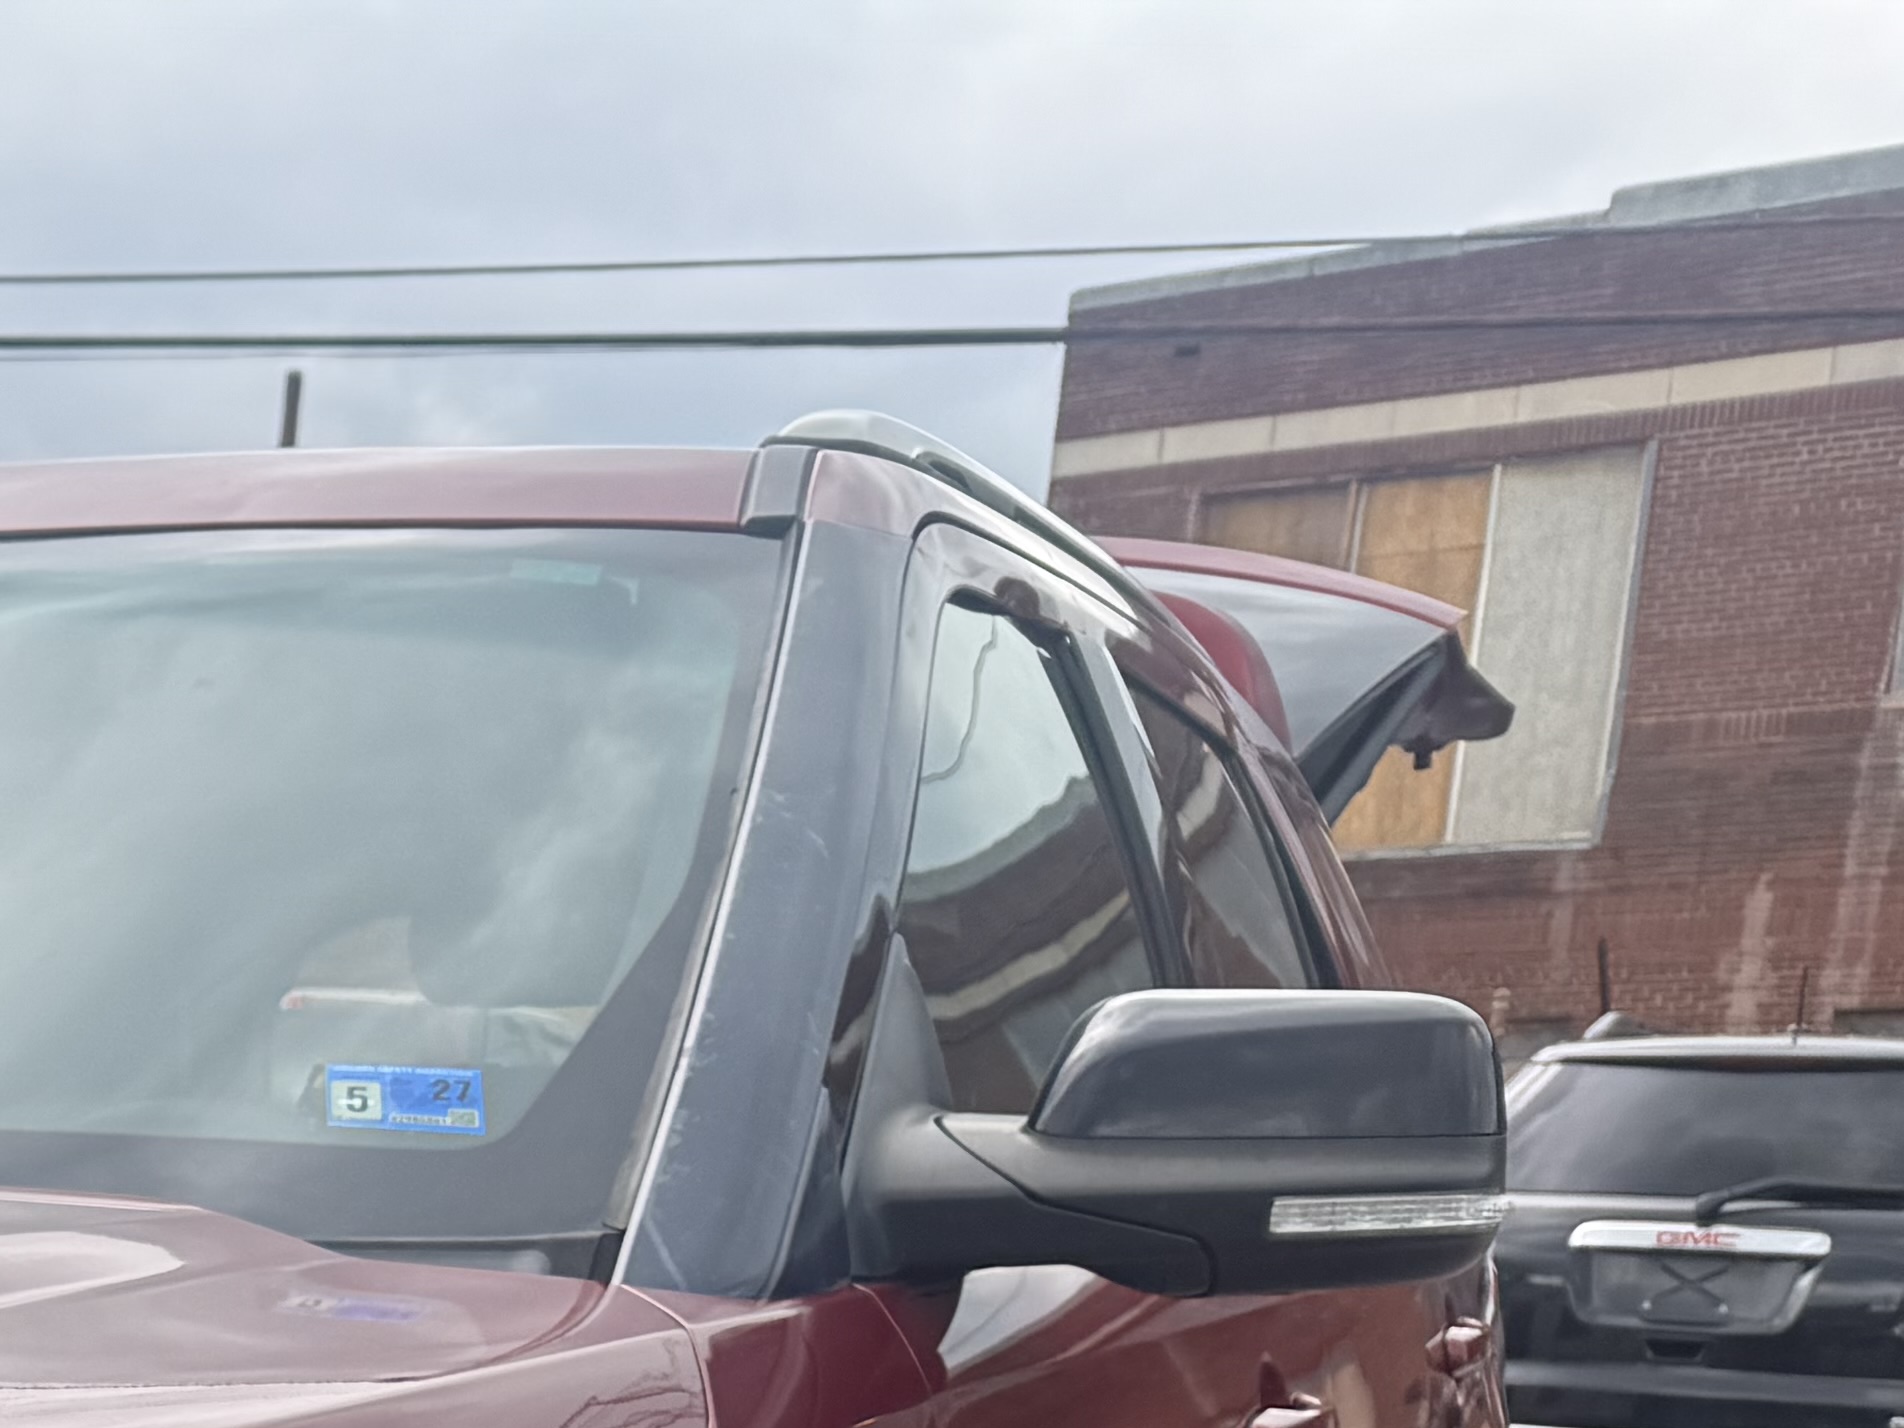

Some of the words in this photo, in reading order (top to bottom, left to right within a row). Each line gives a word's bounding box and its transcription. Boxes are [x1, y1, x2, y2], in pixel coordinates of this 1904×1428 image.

[346, 1086, 369, 1113] 5
[431, 1078, 471, 1103] 27
[1656, 1231, 1741, 1248] GMC
